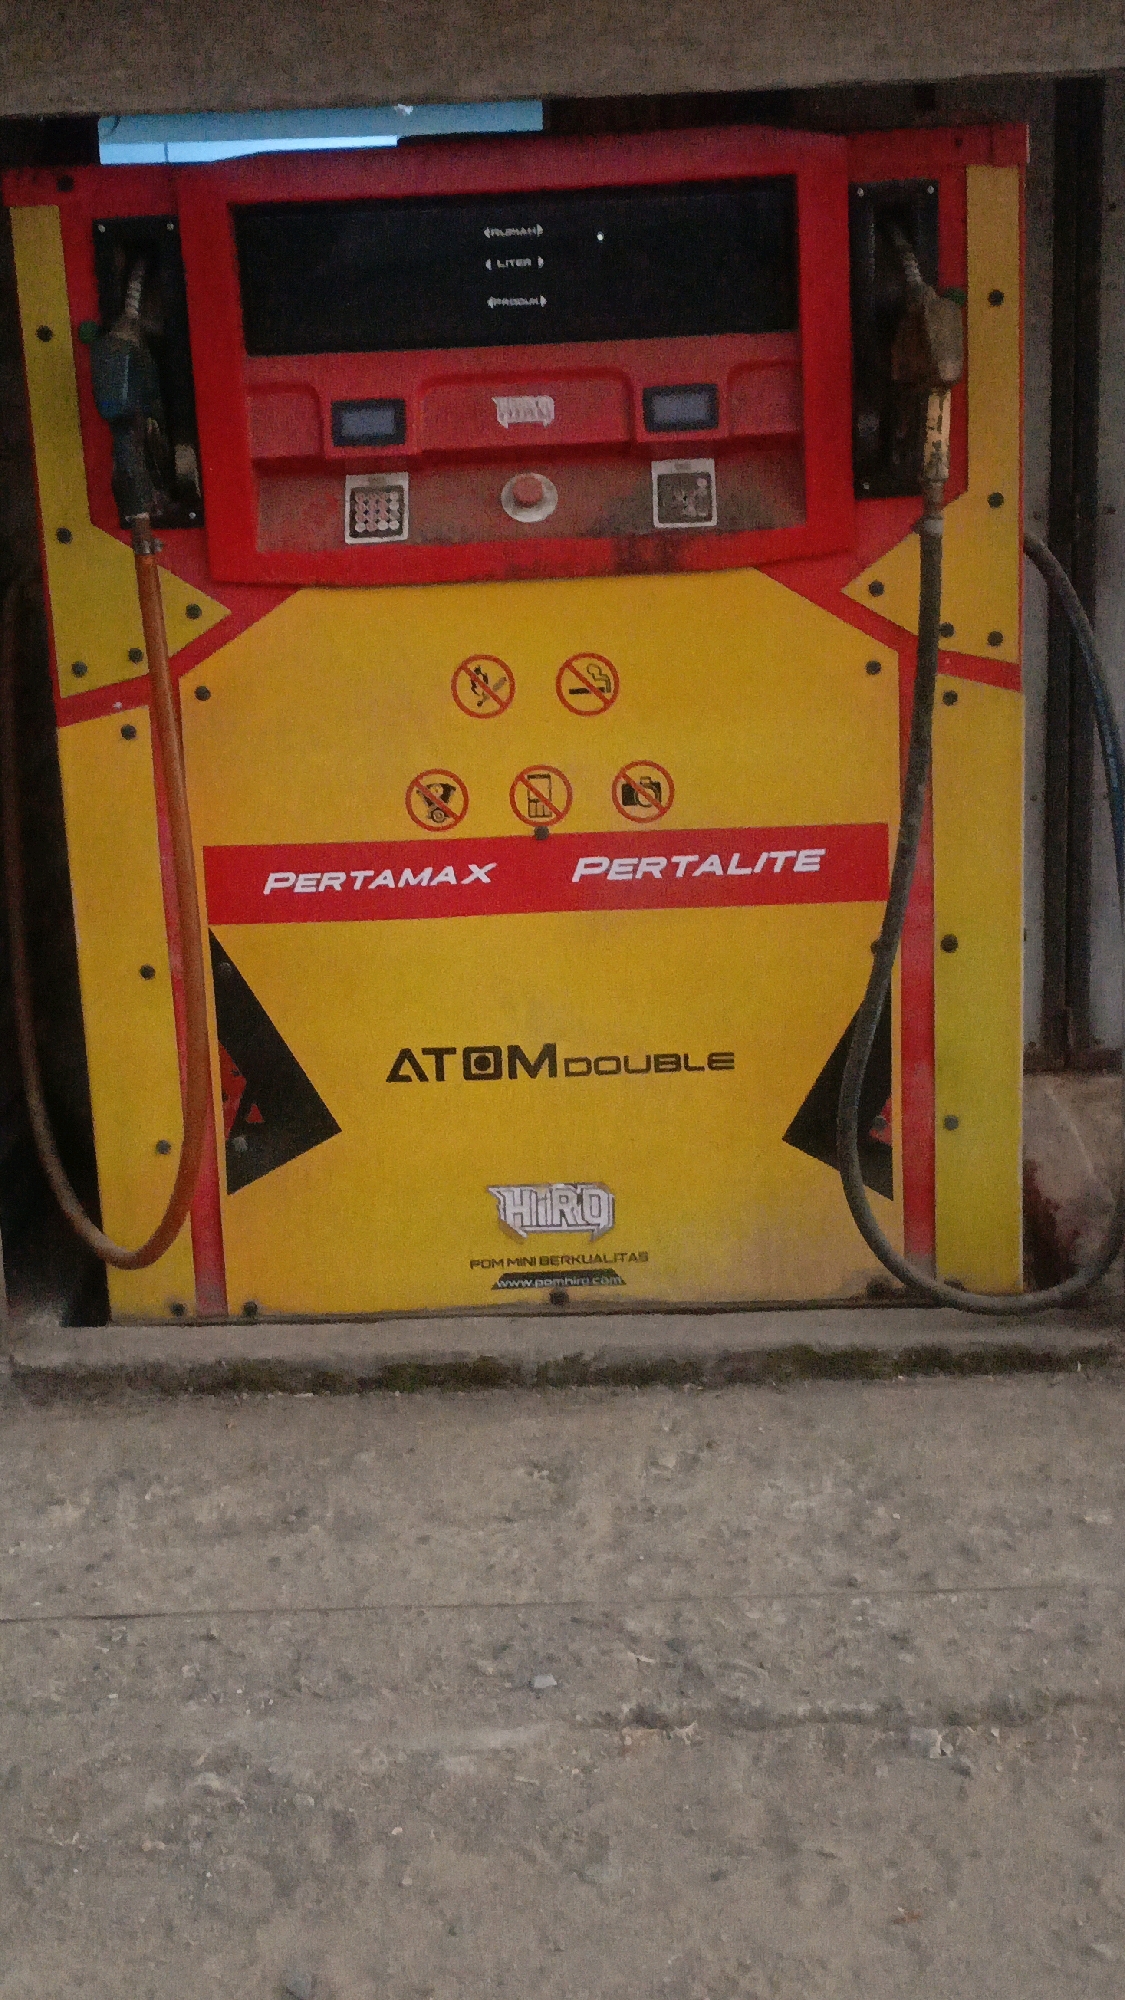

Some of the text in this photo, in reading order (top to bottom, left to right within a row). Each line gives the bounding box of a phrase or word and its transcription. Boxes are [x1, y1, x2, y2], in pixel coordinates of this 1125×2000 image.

[496, 258, 532, 268] LITER
[262, 848, 827, 895] PERTAMAX PERTALITE
[385, 1042, 735, 1083] ATOM DOUBLE
[469, 1251, 649, 1270] POM MINI BERKUALITAS
[496, 1274, 623, 1289] www.pomhiro.com
